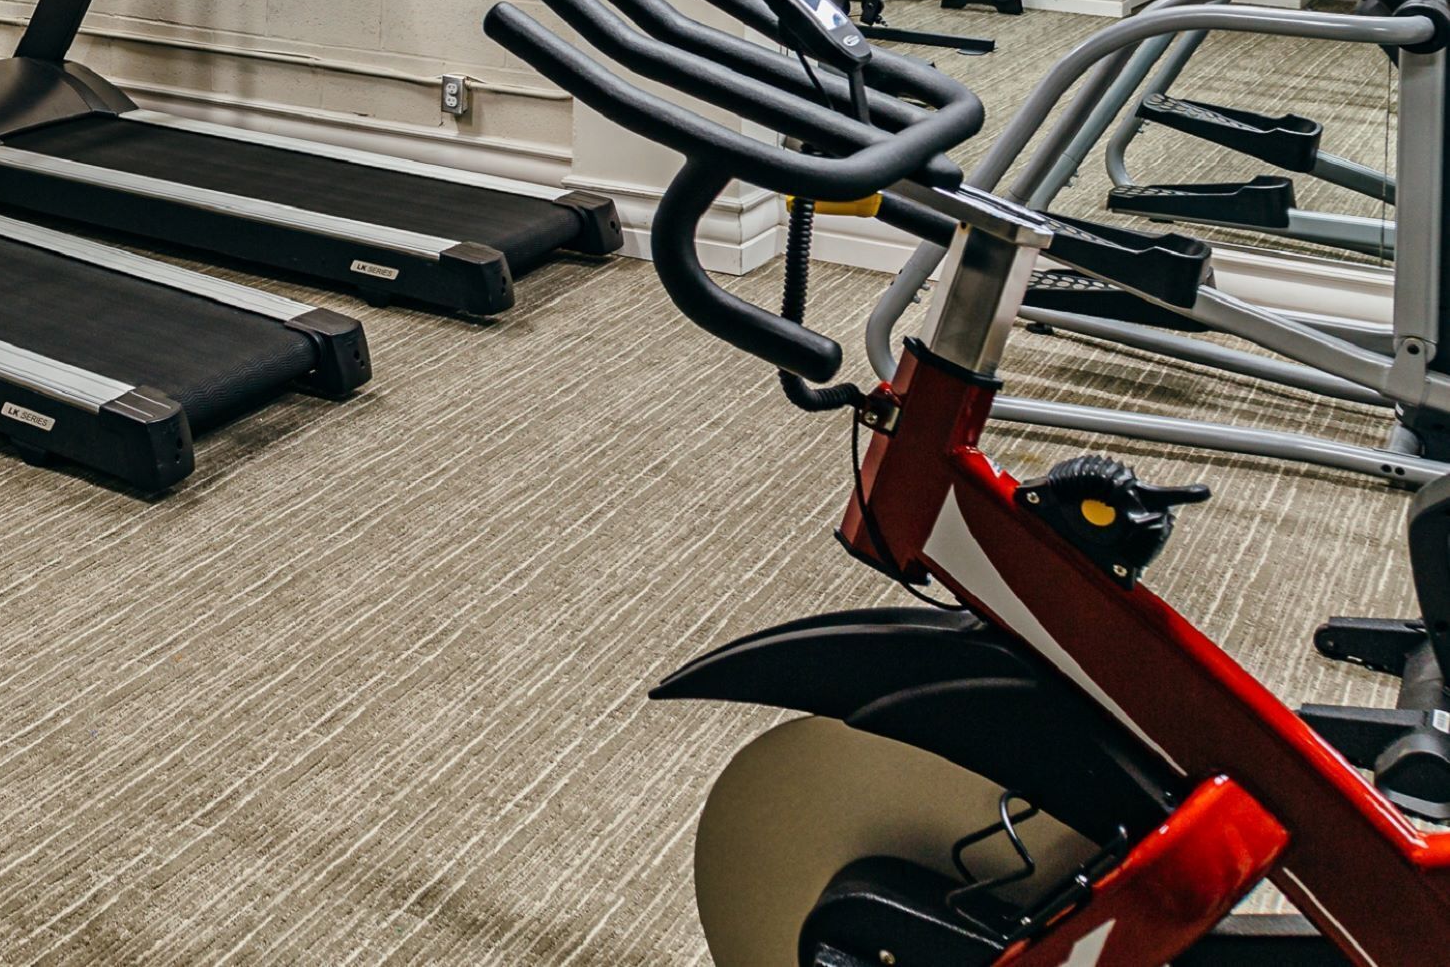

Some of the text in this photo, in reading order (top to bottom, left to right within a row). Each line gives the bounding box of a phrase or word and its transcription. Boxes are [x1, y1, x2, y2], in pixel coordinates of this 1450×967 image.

[356, 263, 368, 272] LK
[7, 407, 48, 427] LK SERIES
